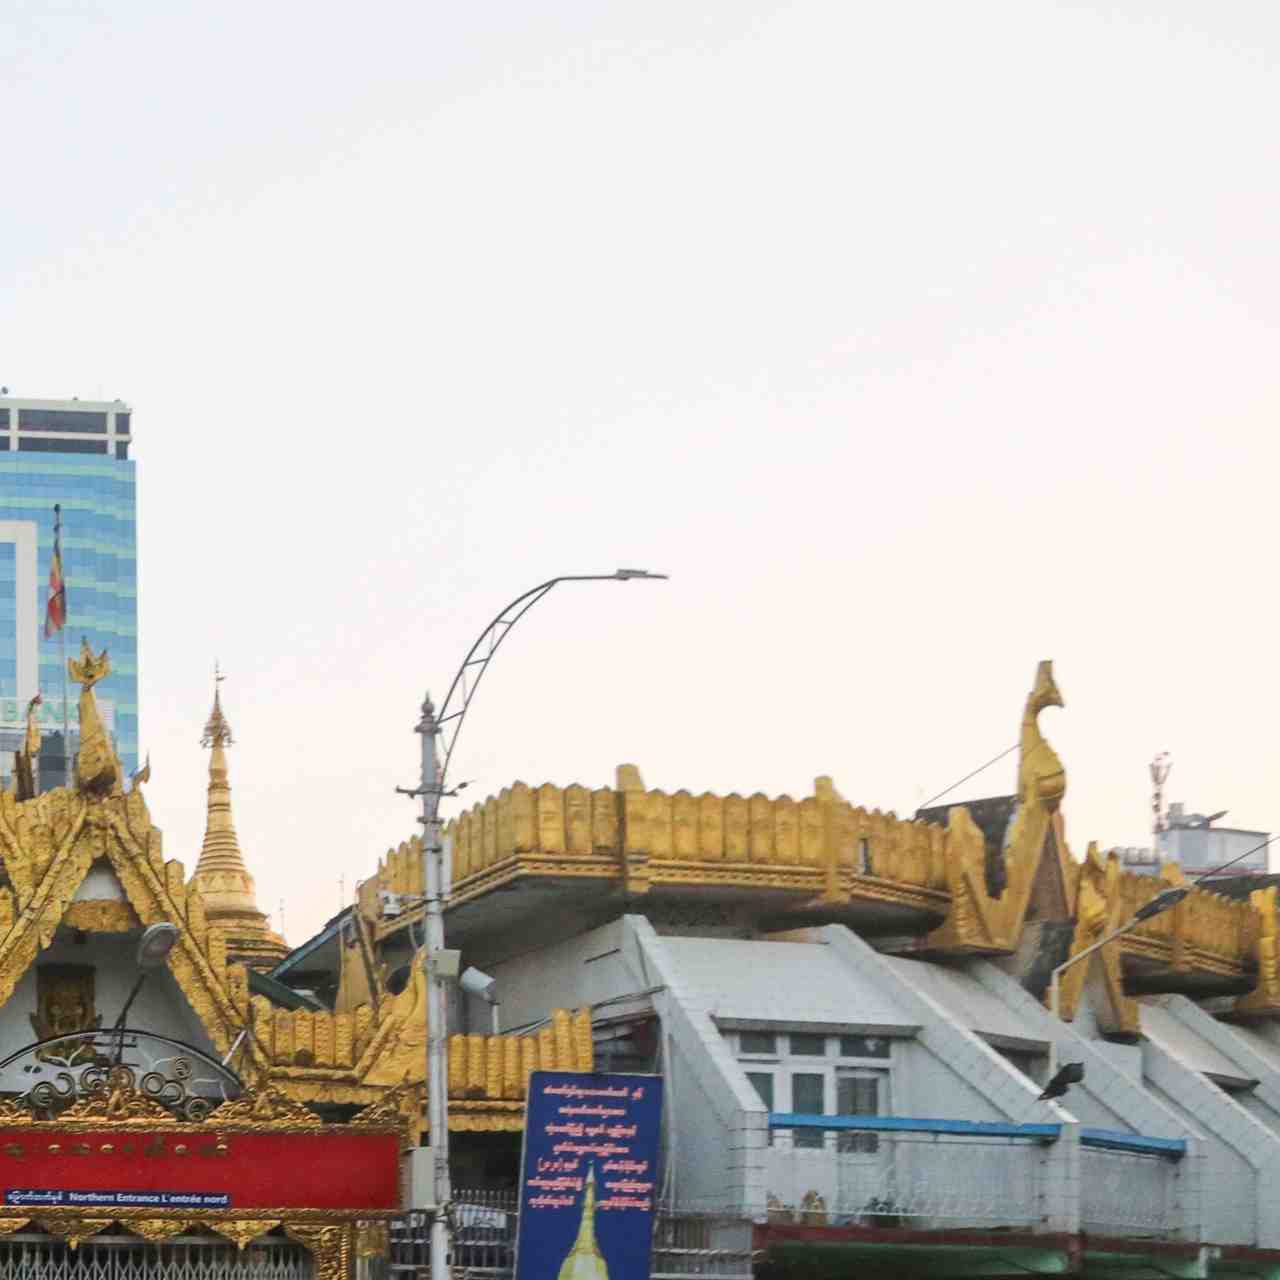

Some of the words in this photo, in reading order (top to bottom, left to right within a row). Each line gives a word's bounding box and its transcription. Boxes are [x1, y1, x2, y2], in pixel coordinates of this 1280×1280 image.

[69, 1192, 114, 1202] Northern
[117, 1193, 160, 1203] Entrance
[204, 1195, 227, 1204] nord
